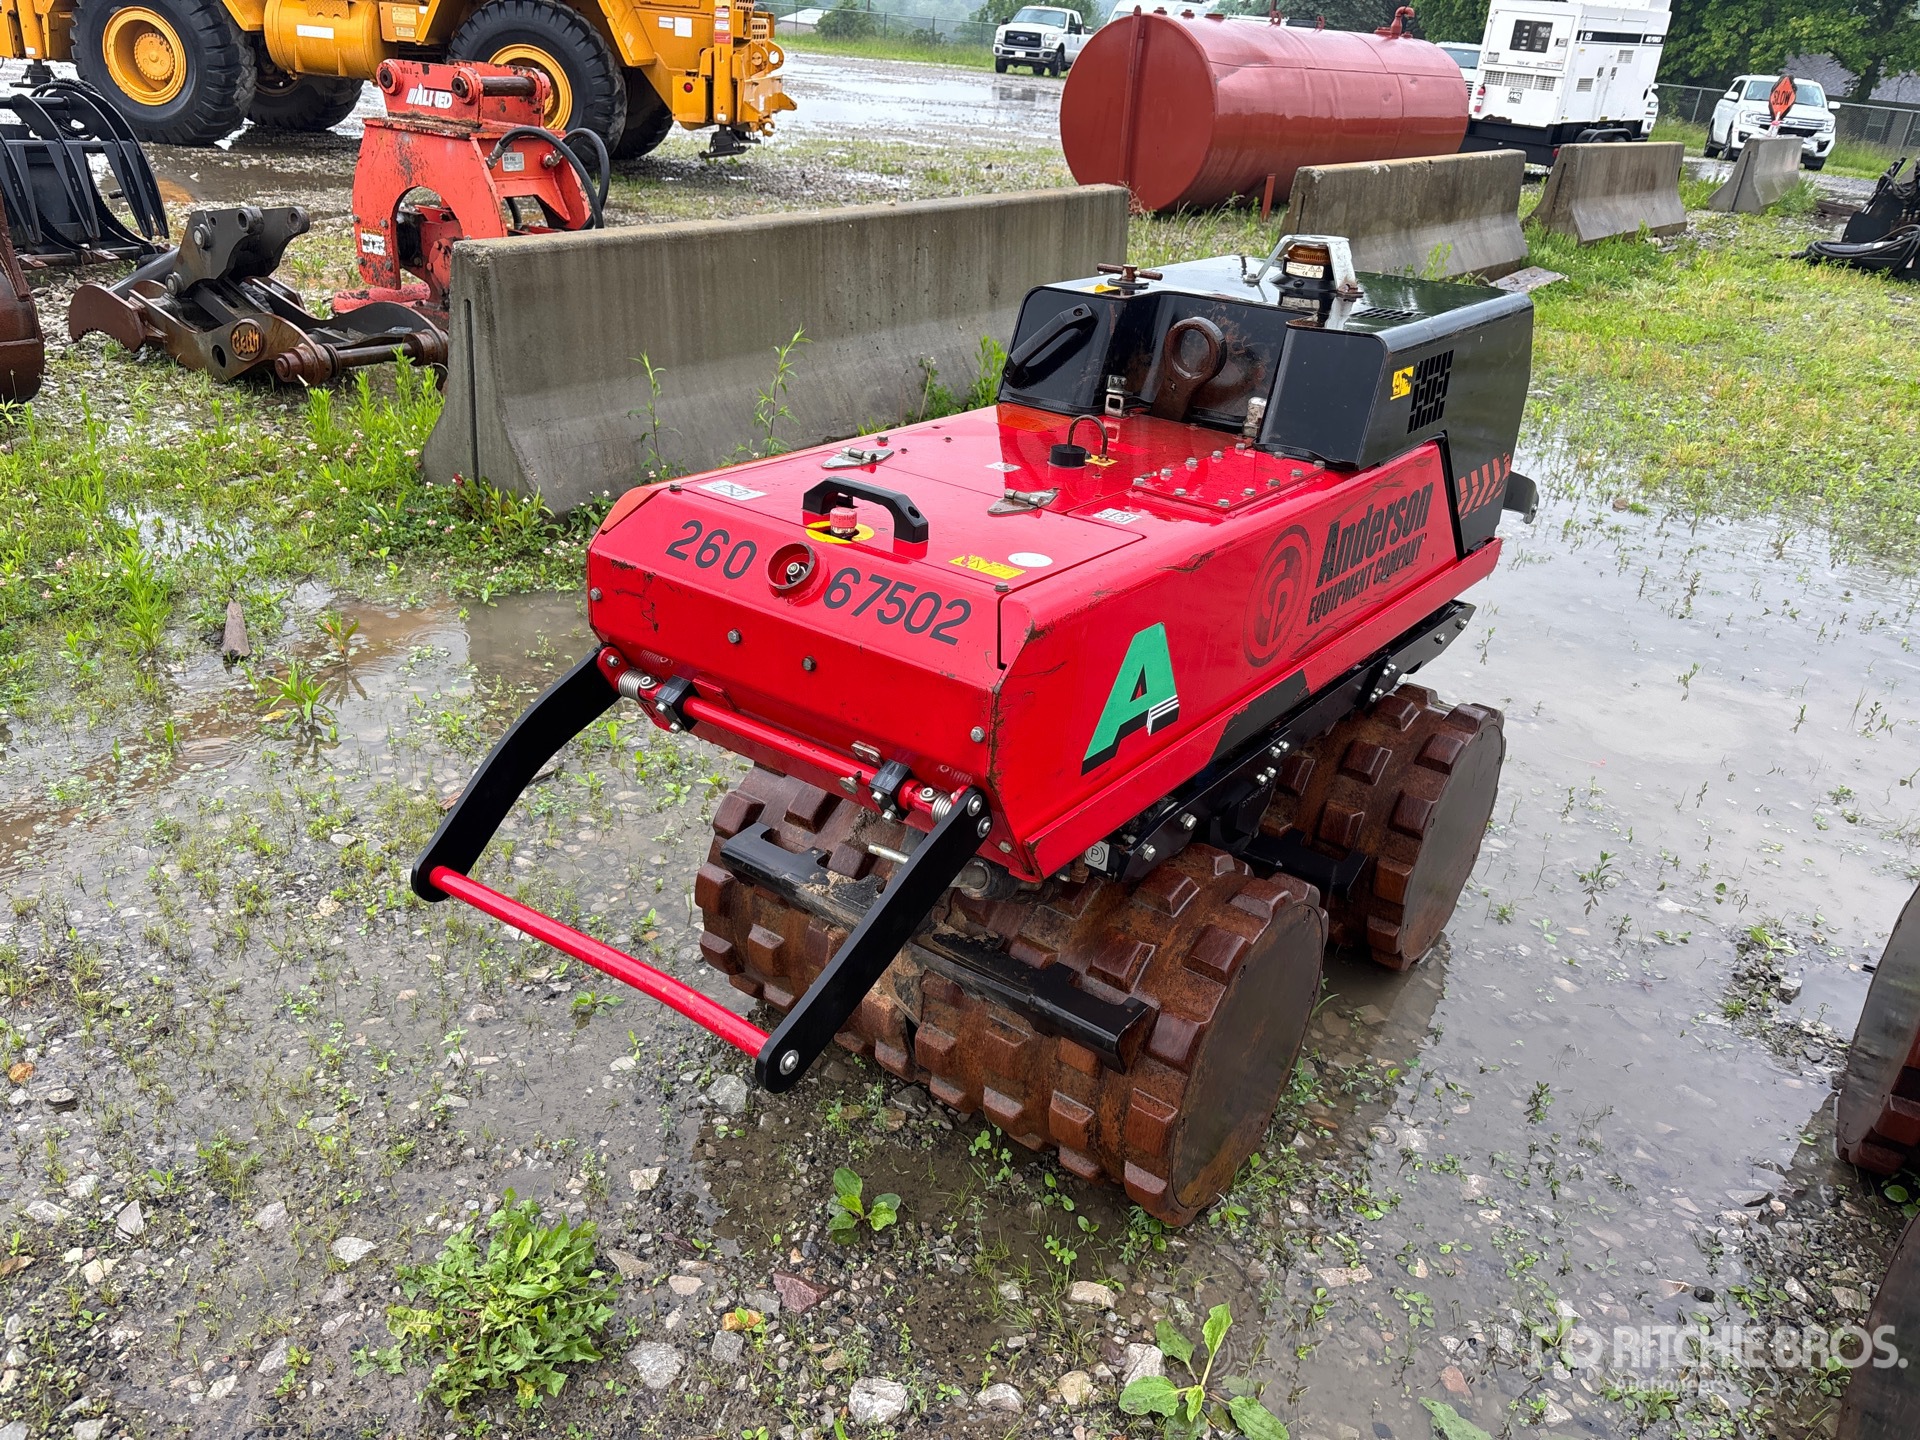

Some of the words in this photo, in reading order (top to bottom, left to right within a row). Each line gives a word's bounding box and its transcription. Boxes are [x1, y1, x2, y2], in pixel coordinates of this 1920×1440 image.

[1772, 89, 1793, 106] SLOW
[665, 519, 758, 580] 260
[1315, 482, 1434, 589] Anderson
[823, 567, 972, 646] 67502
[1306, 561, 1375, 627] EQUIPMENT
[1372, 533, 1425, 586] COMPANY
[1080, 621, 1181, 777] A
